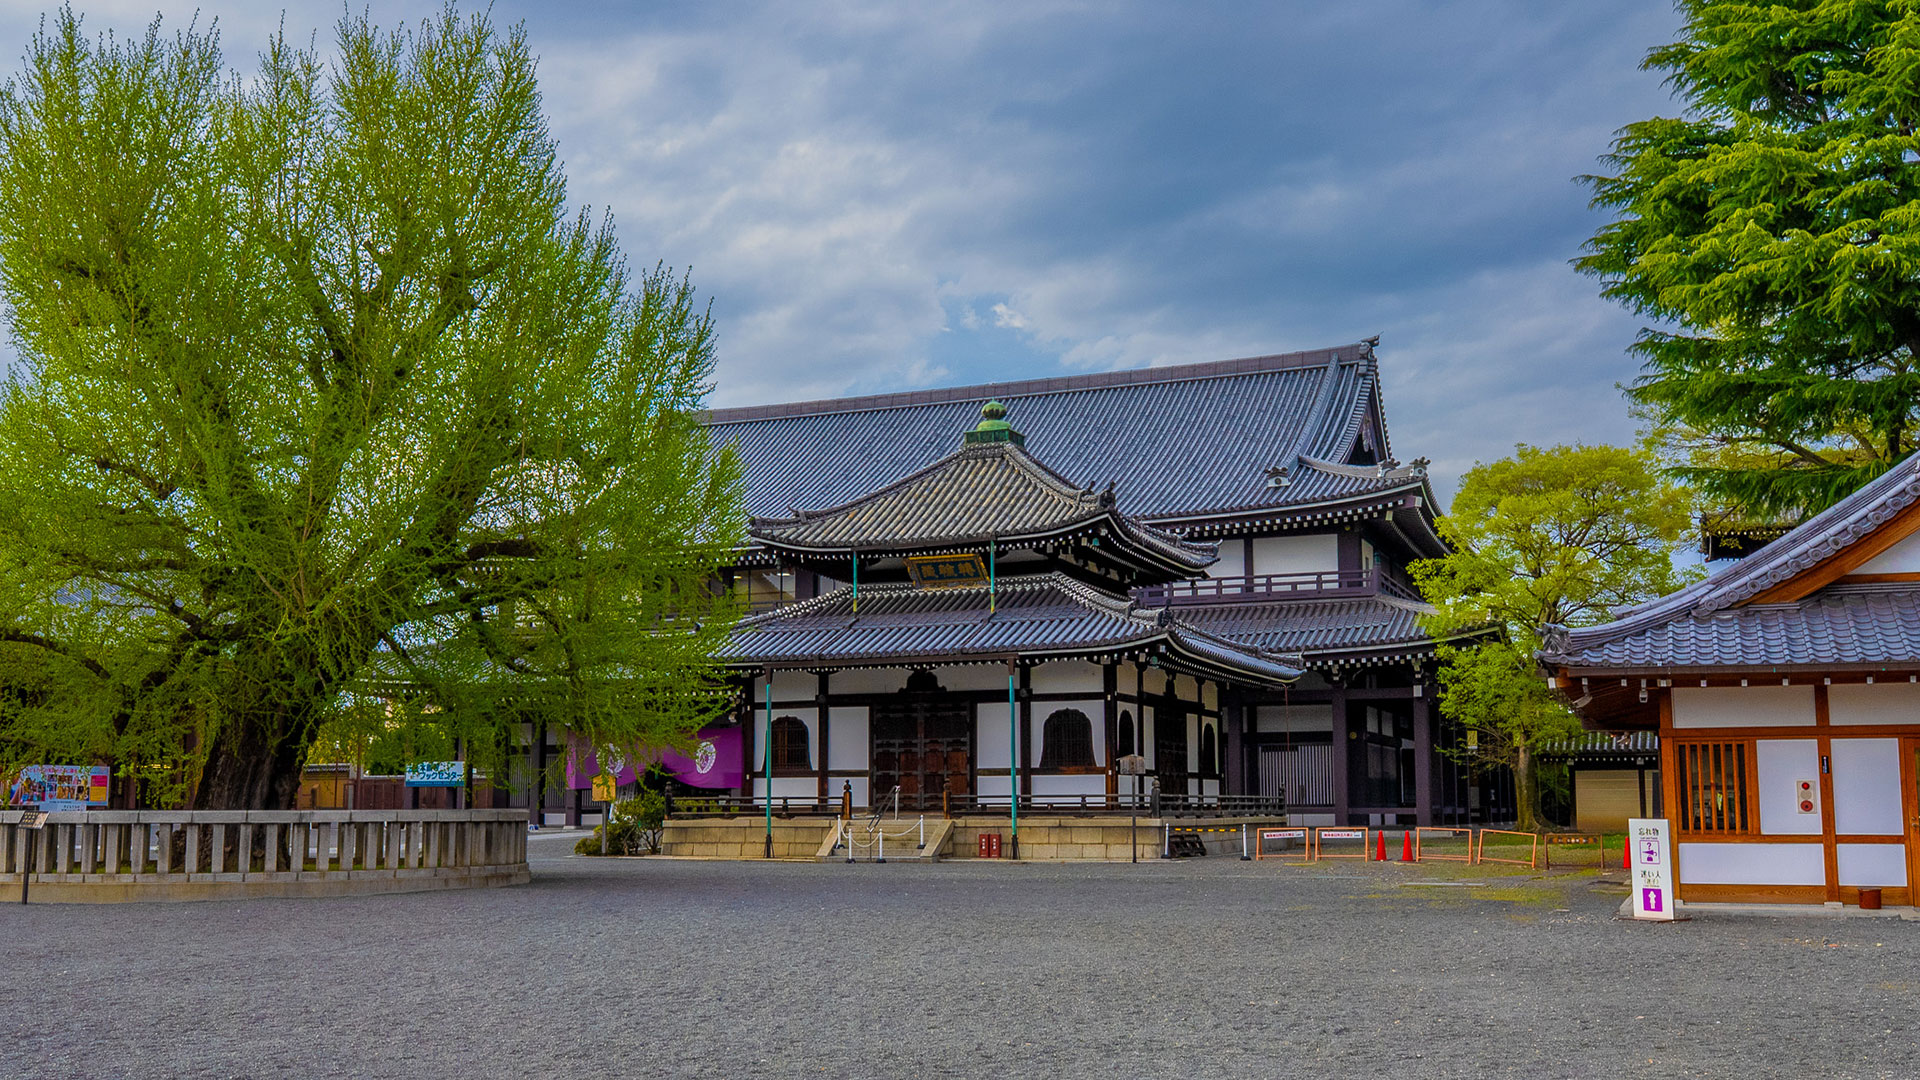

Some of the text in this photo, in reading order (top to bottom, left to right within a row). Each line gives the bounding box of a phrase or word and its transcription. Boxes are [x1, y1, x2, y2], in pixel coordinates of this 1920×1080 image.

[420, 771, 463, 780] ブックセンター
[1638, 827, 1659, 836] 忘れ物
[1640, 870, 1661, 878] 迷い人
